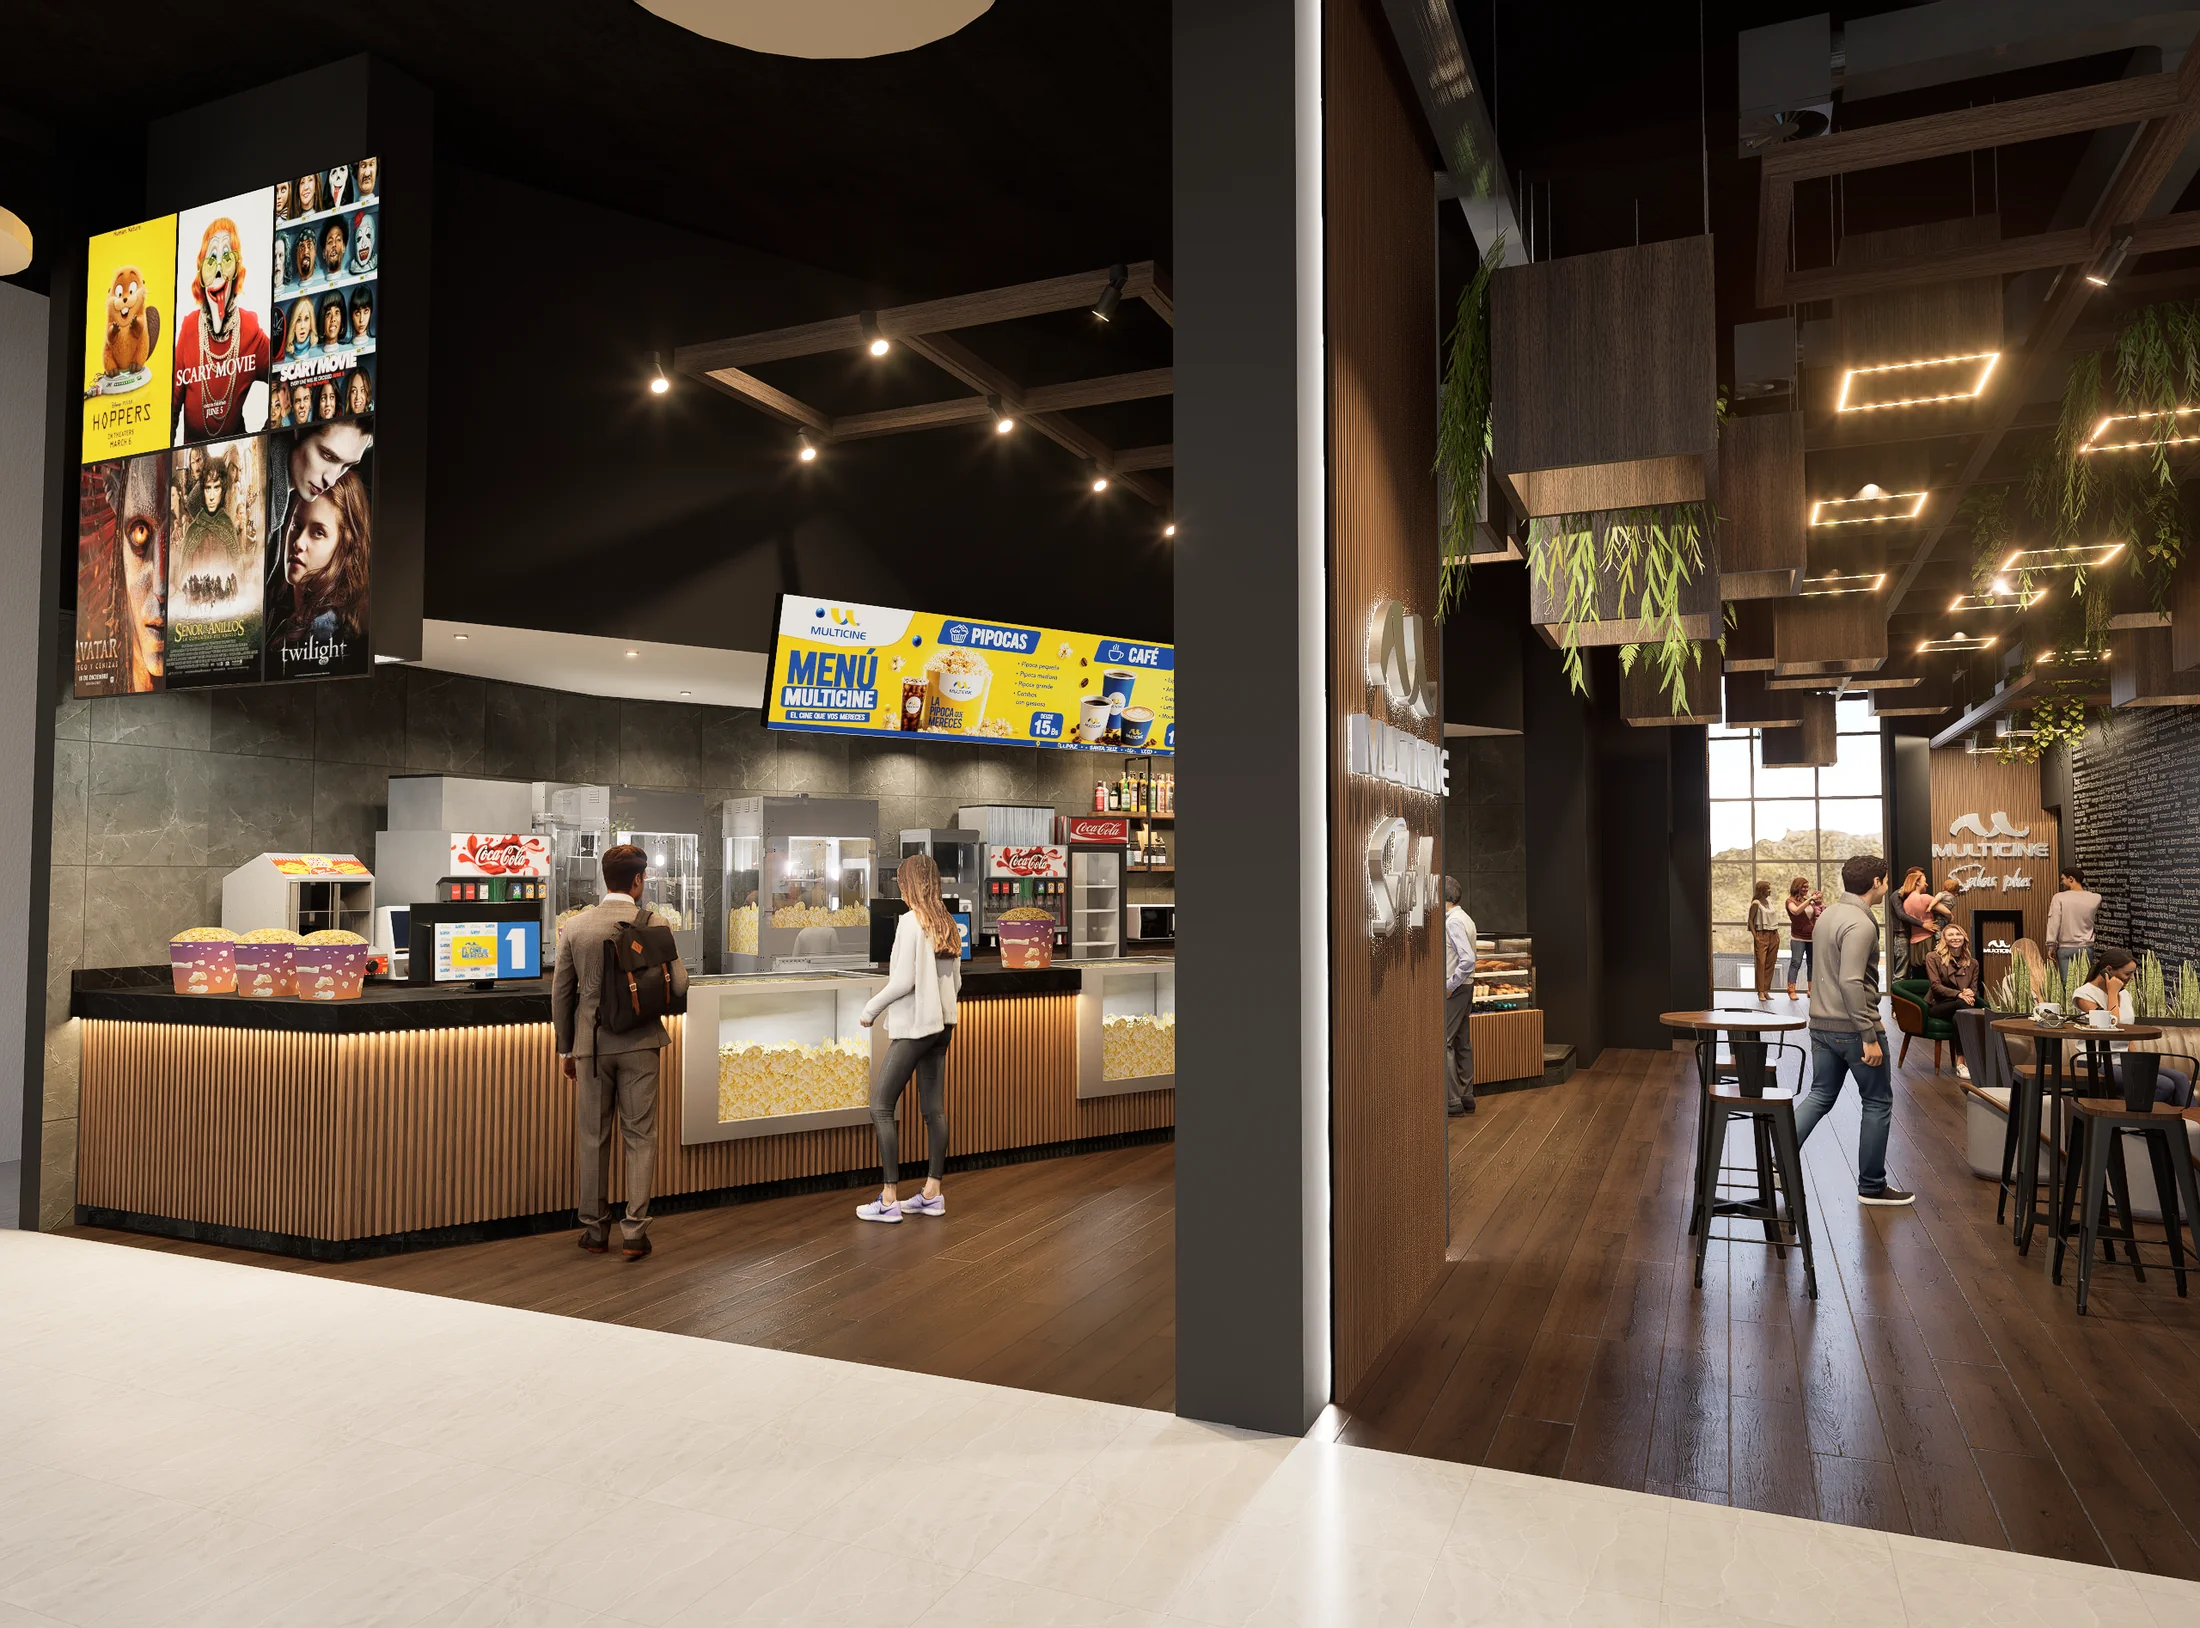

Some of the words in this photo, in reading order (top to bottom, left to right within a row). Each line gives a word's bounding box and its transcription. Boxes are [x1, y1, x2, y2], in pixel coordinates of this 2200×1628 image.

[176, 364, 213, 387] SCARY
[215, 354, 256, 379] MOVIE
[280, 360, 317, 382] SCARY
[316, 352, 357, 374] MOVIE
[92, 403, 151, 431] HOPPERS
[206, 407, 219, 419] JUNE
[219, 406, 224, 414] 5
[113, 429, 135, 438] THEATERS
[109, 439, 127, 448] MARCH
[208, 619, 245, 637] ANILLOS
[810, 626, 867, 641] MULTICINE
[970, 627, 1029, 650] PIPOCAS
[281, 632, 348, 666] twilight
[1128, 647, 1160, 666] CAFÉ
[787, 647, 879, 690] MENÚ
[784, 687, 875, 709] MULTICINE
[931, 695, 940, 706] LA
[790, 711, 798, 719] EL
[929, 705, 954, 717] PIPOCA
[928, 716, 962, 728] MERECES
[1034, 719, 1052, 735] 15
[1075, 821, 1122, 837] Coca-Cola
[475, 844, 527, 867] Coca-Cola
[1931, 842, 2050, 858] MULTICINE
[1009, 853, 1049, 870] Coca-Cola
[505, 928, 526, 970] 1
